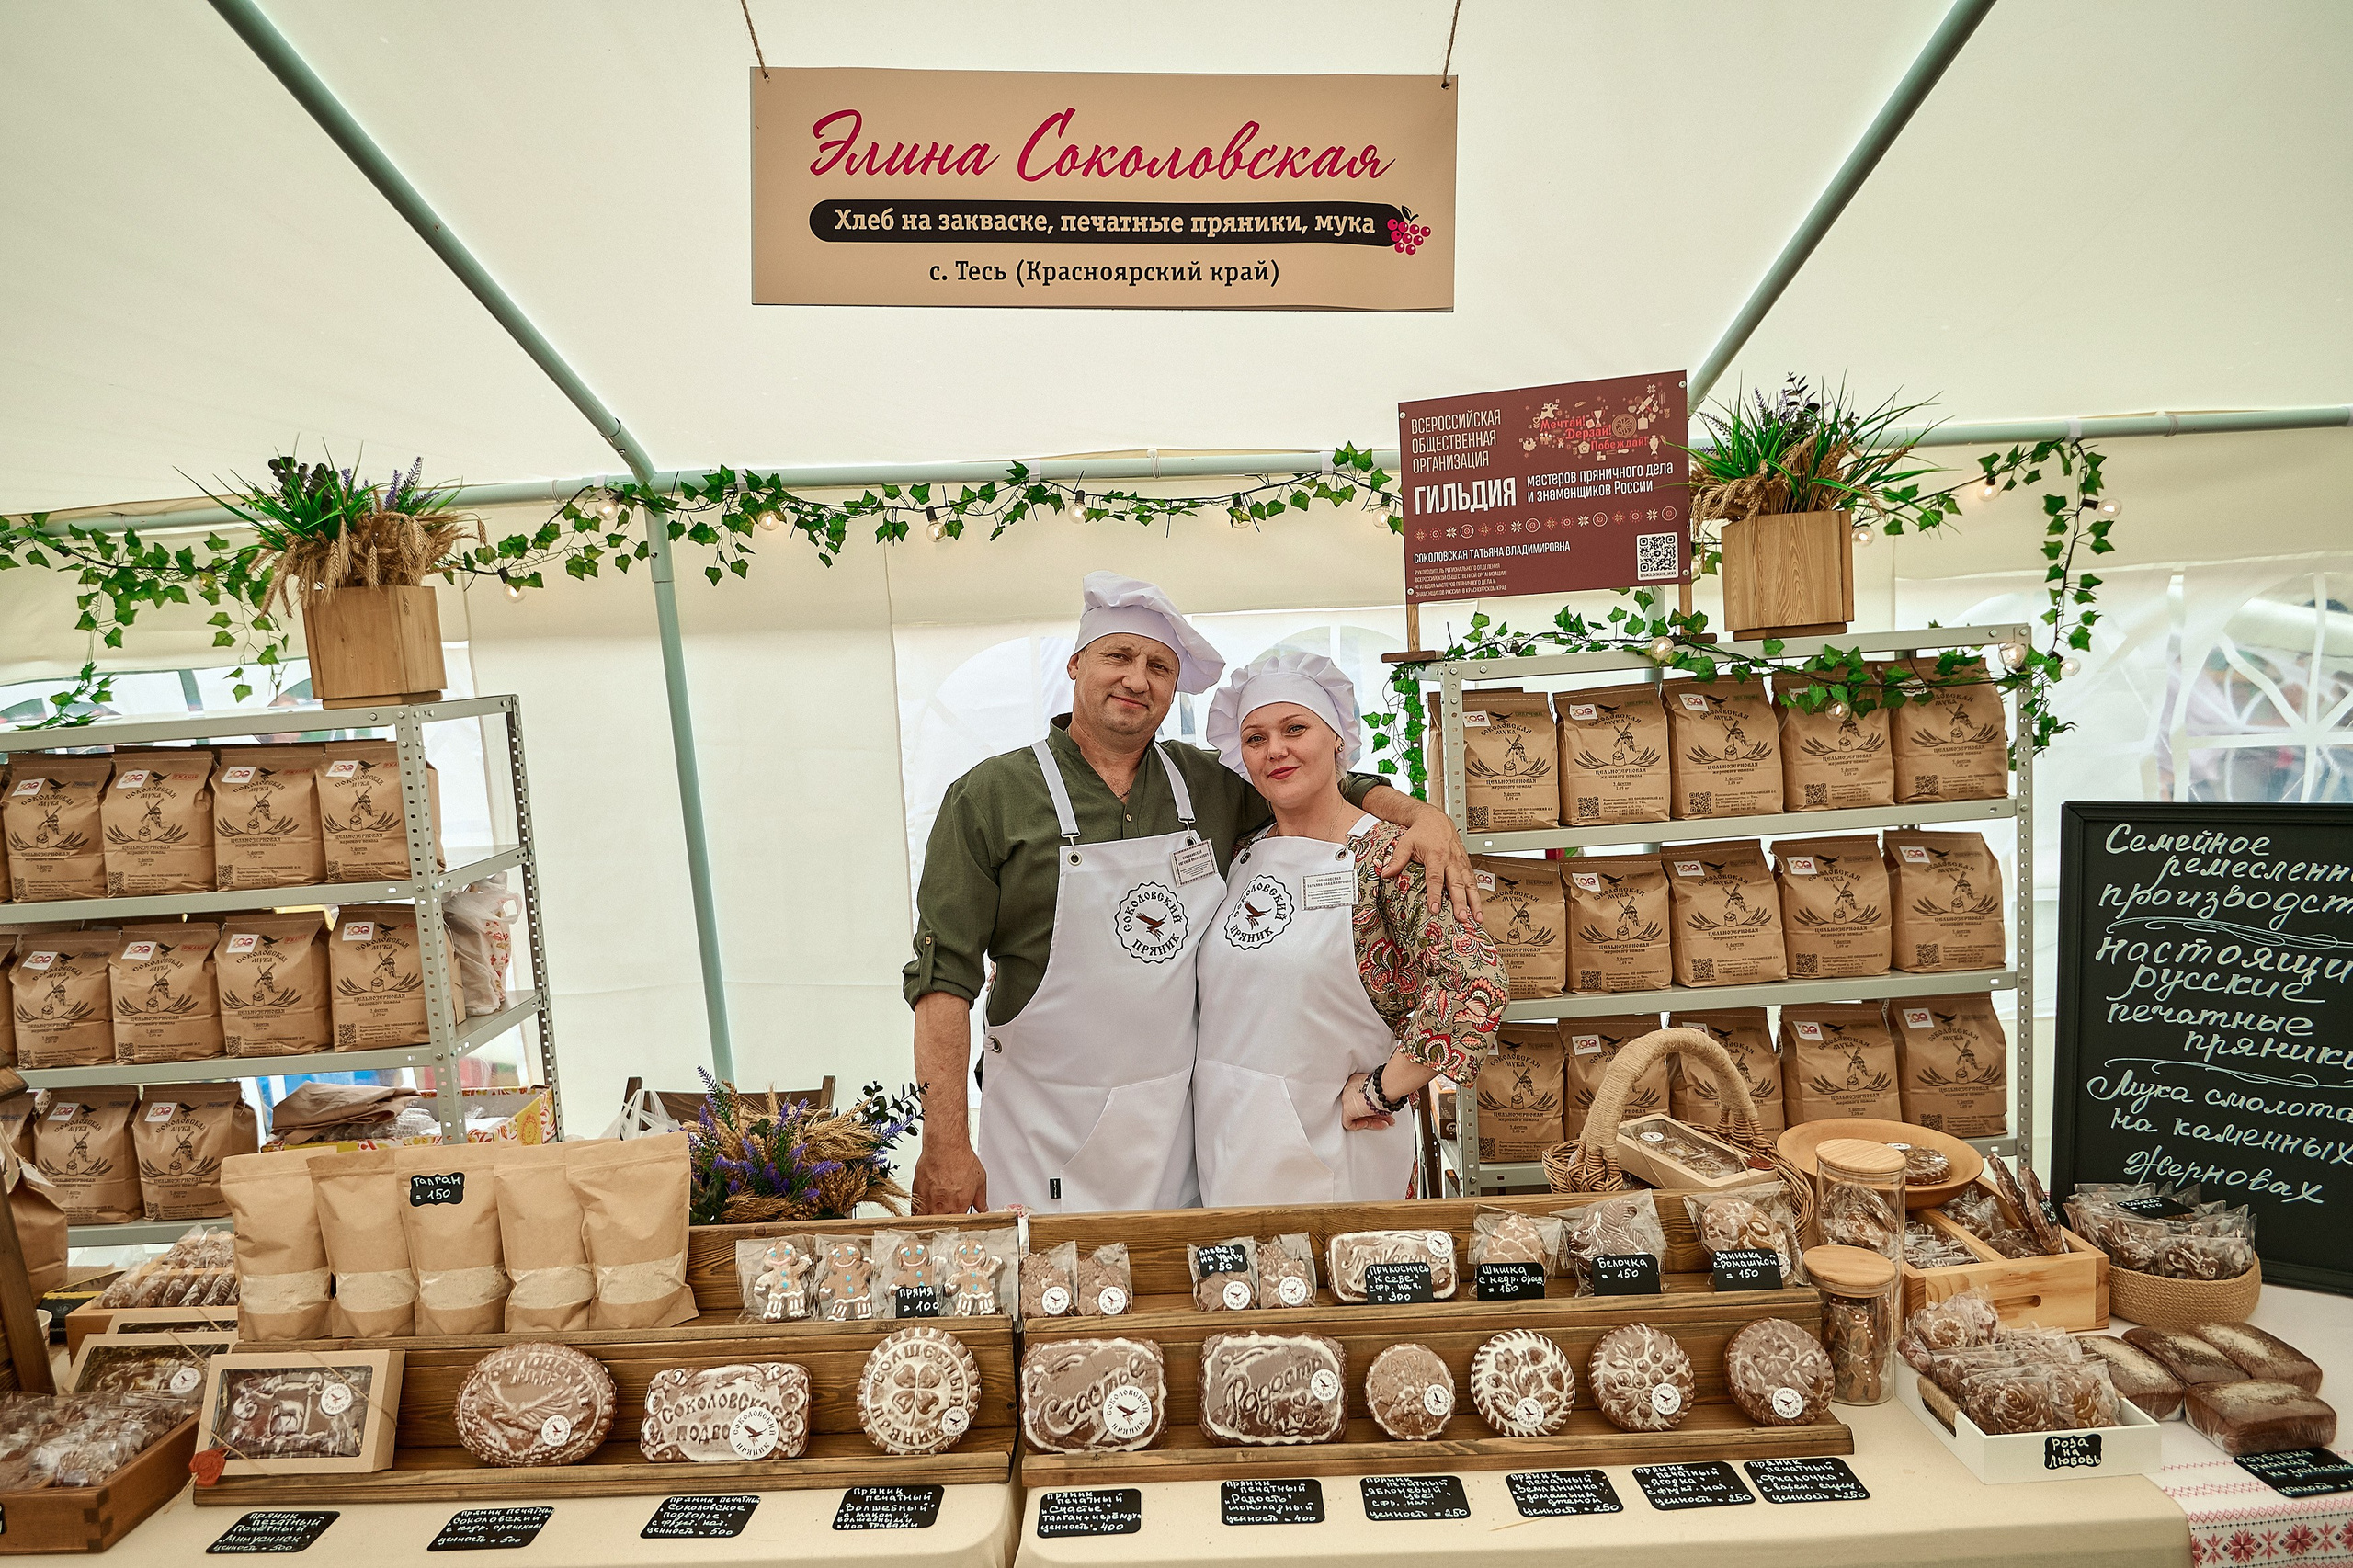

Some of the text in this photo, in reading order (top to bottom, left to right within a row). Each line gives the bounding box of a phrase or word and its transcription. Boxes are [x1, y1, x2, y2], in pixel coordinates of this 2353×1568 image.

[810, 108, 1396, 182] Элина Соколовская
[834, 208, 1375, 239] Хлеб на закваске, печатные пряники, мука
[929, 258, 1280, 288] с. Тесь (Красноярский край)
[1411, 409, 1501, 435] ВСЕРОССИЙСКАЯ
[1540, 415, 1586, 432] Мечтай!
[1564, 425, 1612, 440] Дерзай!
[1412, 430, 1496, 454] ОБЩЕСТВЕННАЯ
[1591, 436, 1649, 451] Побеждай!
[1413, 451, 1489, 474] ОРГАНИЗАЦИЯ
[1527, 461, 1674, 488] мастеров пряничного дела
[1414, 477, 1517, 515] ГИЛЬДИЯ
[1528, 479, 1654, 504] и знаменщиков России
[1414, 540, 1571, 564] СОКОЛОВСКАЯ ТАТЬЯНА ВЛАДИМИРОВНА
[2105, 823, 2270, 856] Семейное
[2153, 854, 2353, 889] ремесленн
[1123, 889, 1183, 933] СОКОЛОВСКИЙ
[1131, 932, 1181, 957] ПРЯНИК
[1229, 924, 1274, 944] ПРЯНИК
[2106, 963, 2325, 1004] русские
[2106, 999, 2313, 1036] печатные
[2086, 1069, 2194, 1110] Мука
[2110, 1108, 2158, 1133] на
[427, 1188, 451, 1200] 150
[1482, 1265, 1527, 1276] Шишка
[1597, 1257, 1648, 1268] Белочка
[1618, 1269, 1639, 1279] 150
[1738, 1268, 1759, 1278] 150
[915, 1301, 939, 1312] 100
[1388, 1291, 1411, 1301] 300
[2063, 1449, 2080, 1457] на
[1594, 1503, 1620, 1512] 250
[1728, 1493, 1752, 1502] 250
[1294, 1514, 1316, 1522] 400
[1444, 1508, 1468, 1517] 250
[1100, 1522, 1124, 1532] 400
